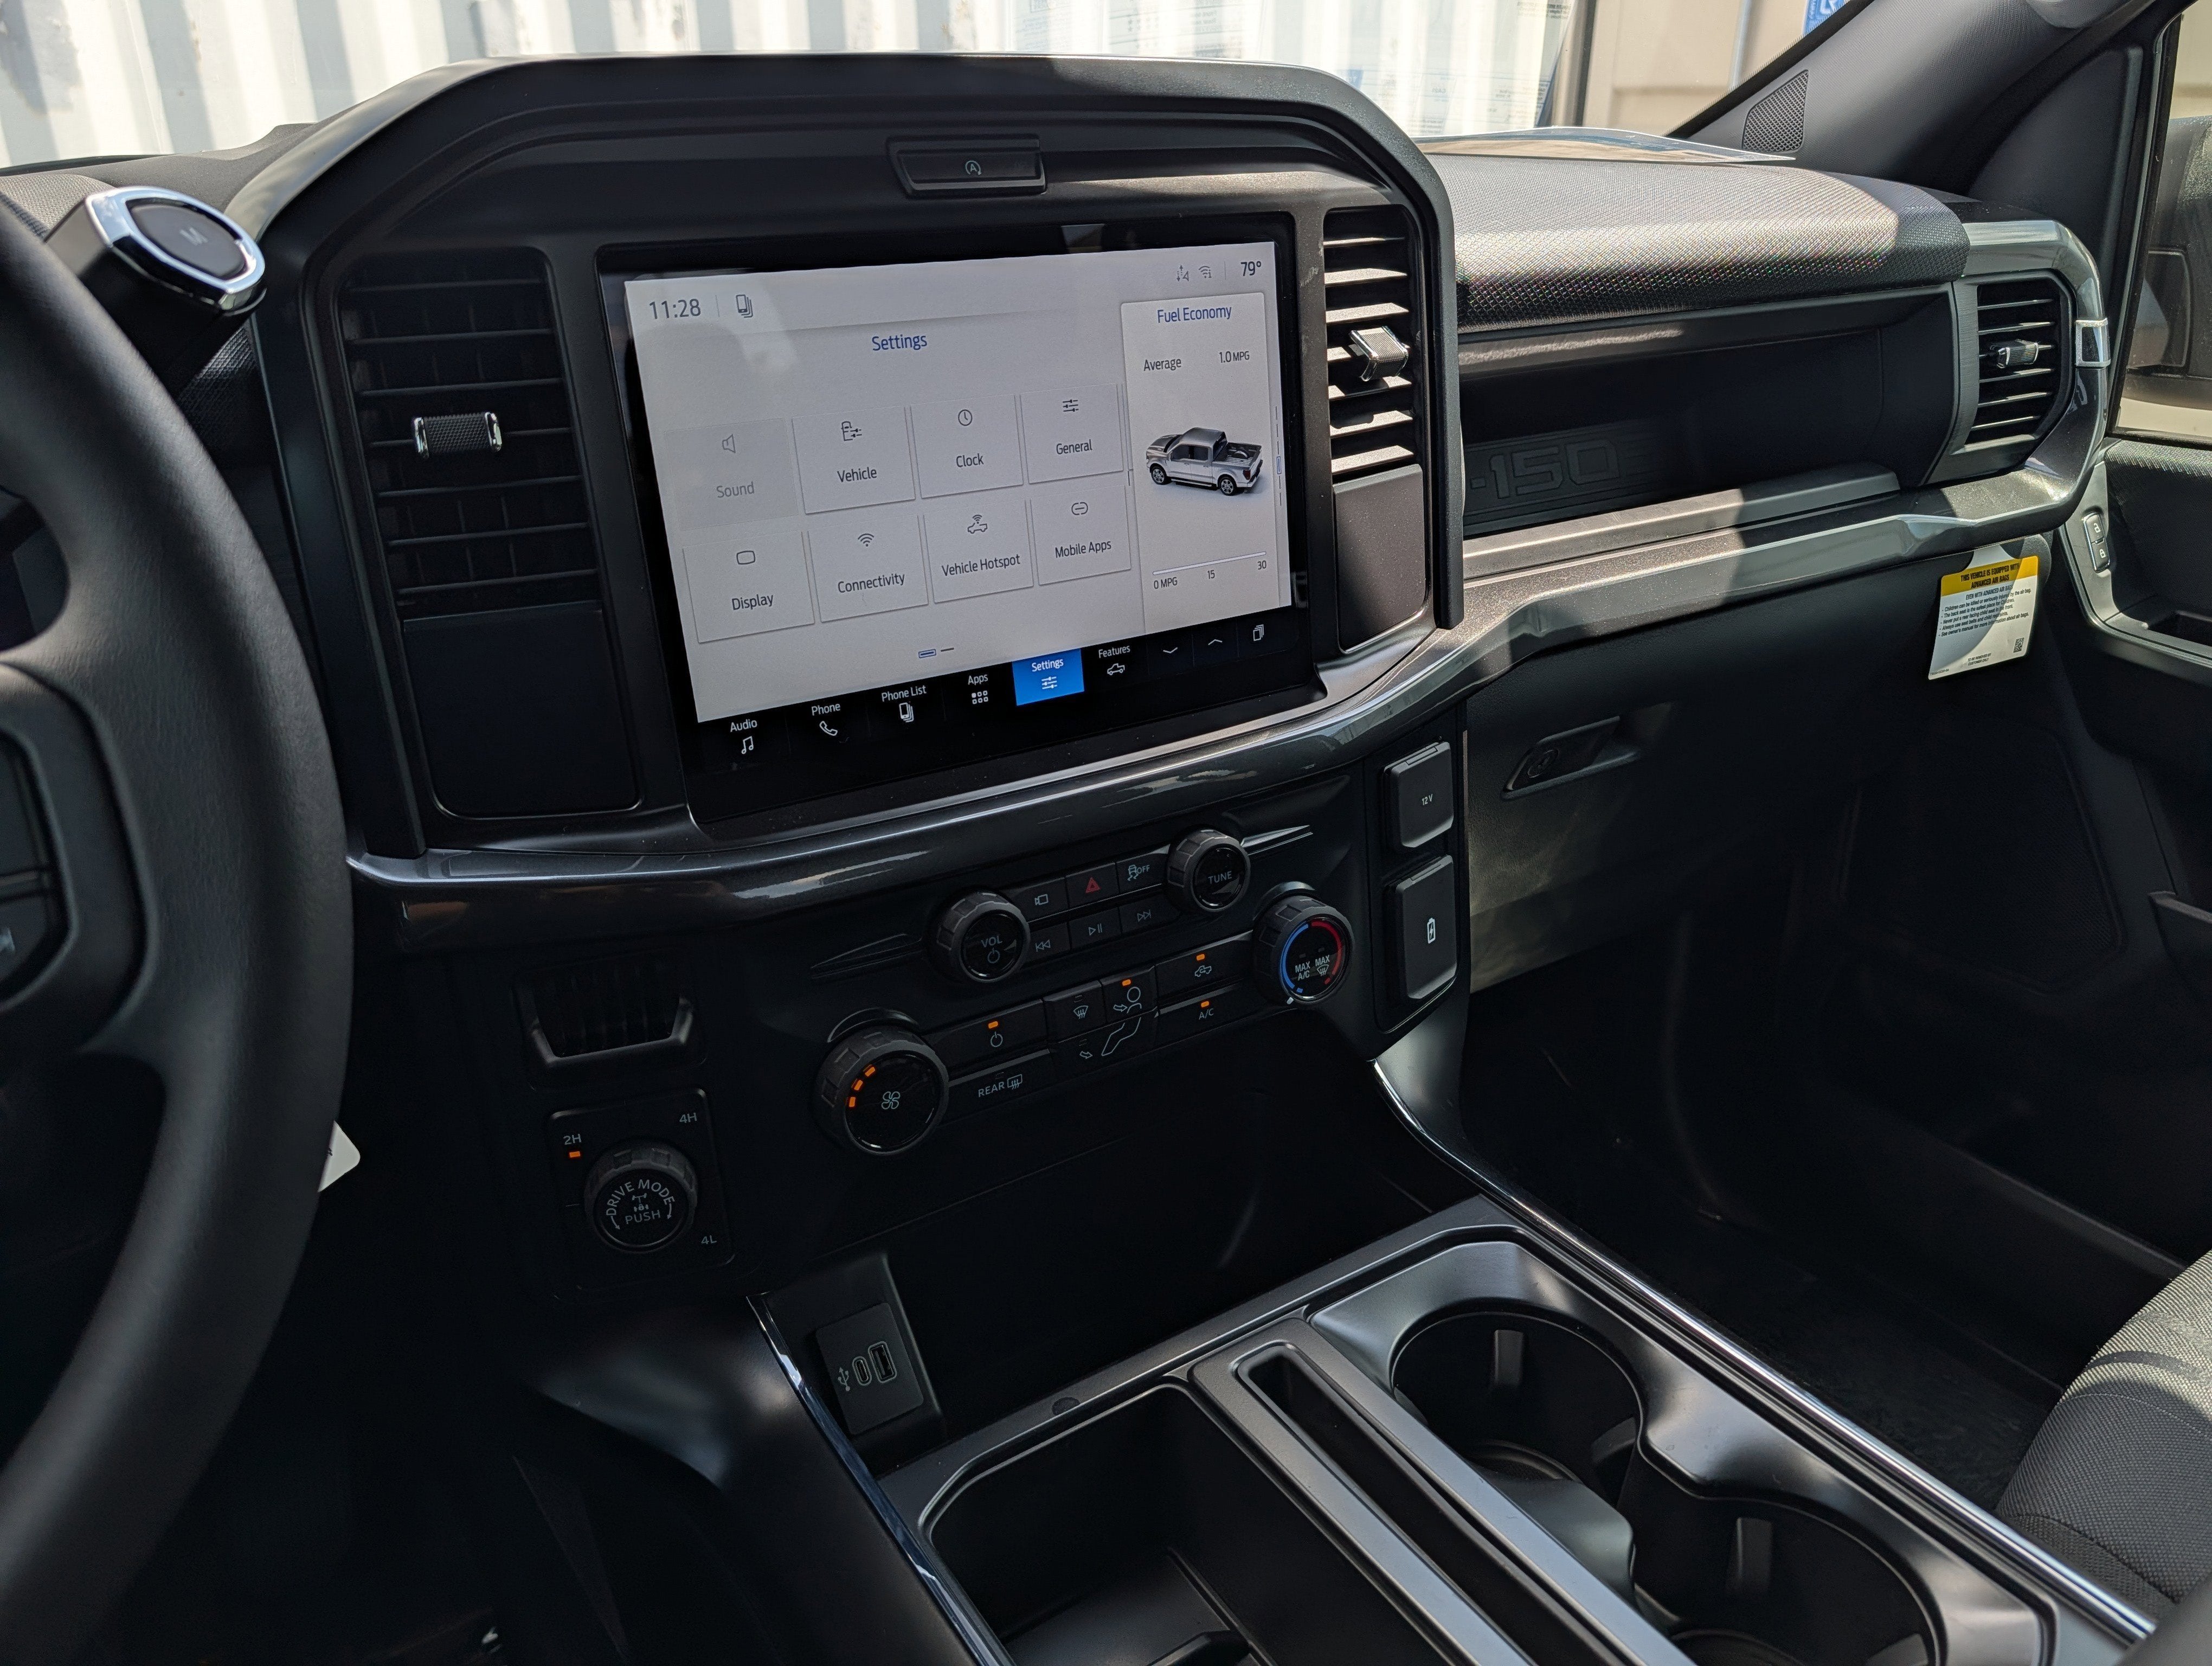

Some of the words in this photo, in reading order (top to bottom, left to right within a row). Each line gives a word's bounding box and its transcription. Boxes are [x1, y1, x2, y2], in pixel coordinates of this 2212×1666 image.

[649, 298, 702, 321] 11:28
[1157, 308, 1181, 323] Fuel
[1183, 305, 1232, 322] Economy
[871, 334, 928, 352] Settings
[1143, 357, 1182, 372] Average
[1219, 351, 1232, 364] 1.0
[1233, 350, 1250, 362] MPG
[1056, 439, 1092, 455] General
[955, 452, 984, 469] Clock
[837, 466, 878, 483] Vehicle
[716, 482, 755, 499] Sound
[1054, 542, 1086, 559] Mobile
[1088, 540, 1112, 555] Apps
[941, 560, 979, 577] Vehicle
[980, 553, 1021, 572] Hotspot
[1257, 560, 1267, 571] 30
[1207, 569, 1216, 579] 15
[837, 572, 905, 594] Connectivity
[1153, 580, 1159, 589] 0
[1160, 576, 1178, 588] MPG
[731, 593, 774, 611] Display
[1098, 644, 1131, 659] Features
[1031, 657, 1064, 672] Settings
[967, 673, 988, 685] Apps
[882, 688, 909, 702] Phone
[911, 684, 927, 696] List
[811, 702, 841, 716] Phone
[730, 718, 758, 733] Audio
[1137, 864, 1150, 874] OFF
[1207, 870, 1232, 883] TUNE
[981, 935, 1003, 947] VOL
[1295, 961, 1310, 973] MAX
[1315, 954, 1330, 966] MAX
[1297, 970, 1310, 981] A/C
[1198, 1008, 1214, 1021] A/C
[978, 1081, 1005, 1098] REAR
[679, 1112, 698, 1124] 4H
[563, 1133, 582, 1145] 2H
[606, 1182, 634, 1216] DRIVE
[638, 1179, 675, 1205] MODE
[625, 1210, 661, 1225] PUSH
[701, 1235, 717, 1245] 4L
